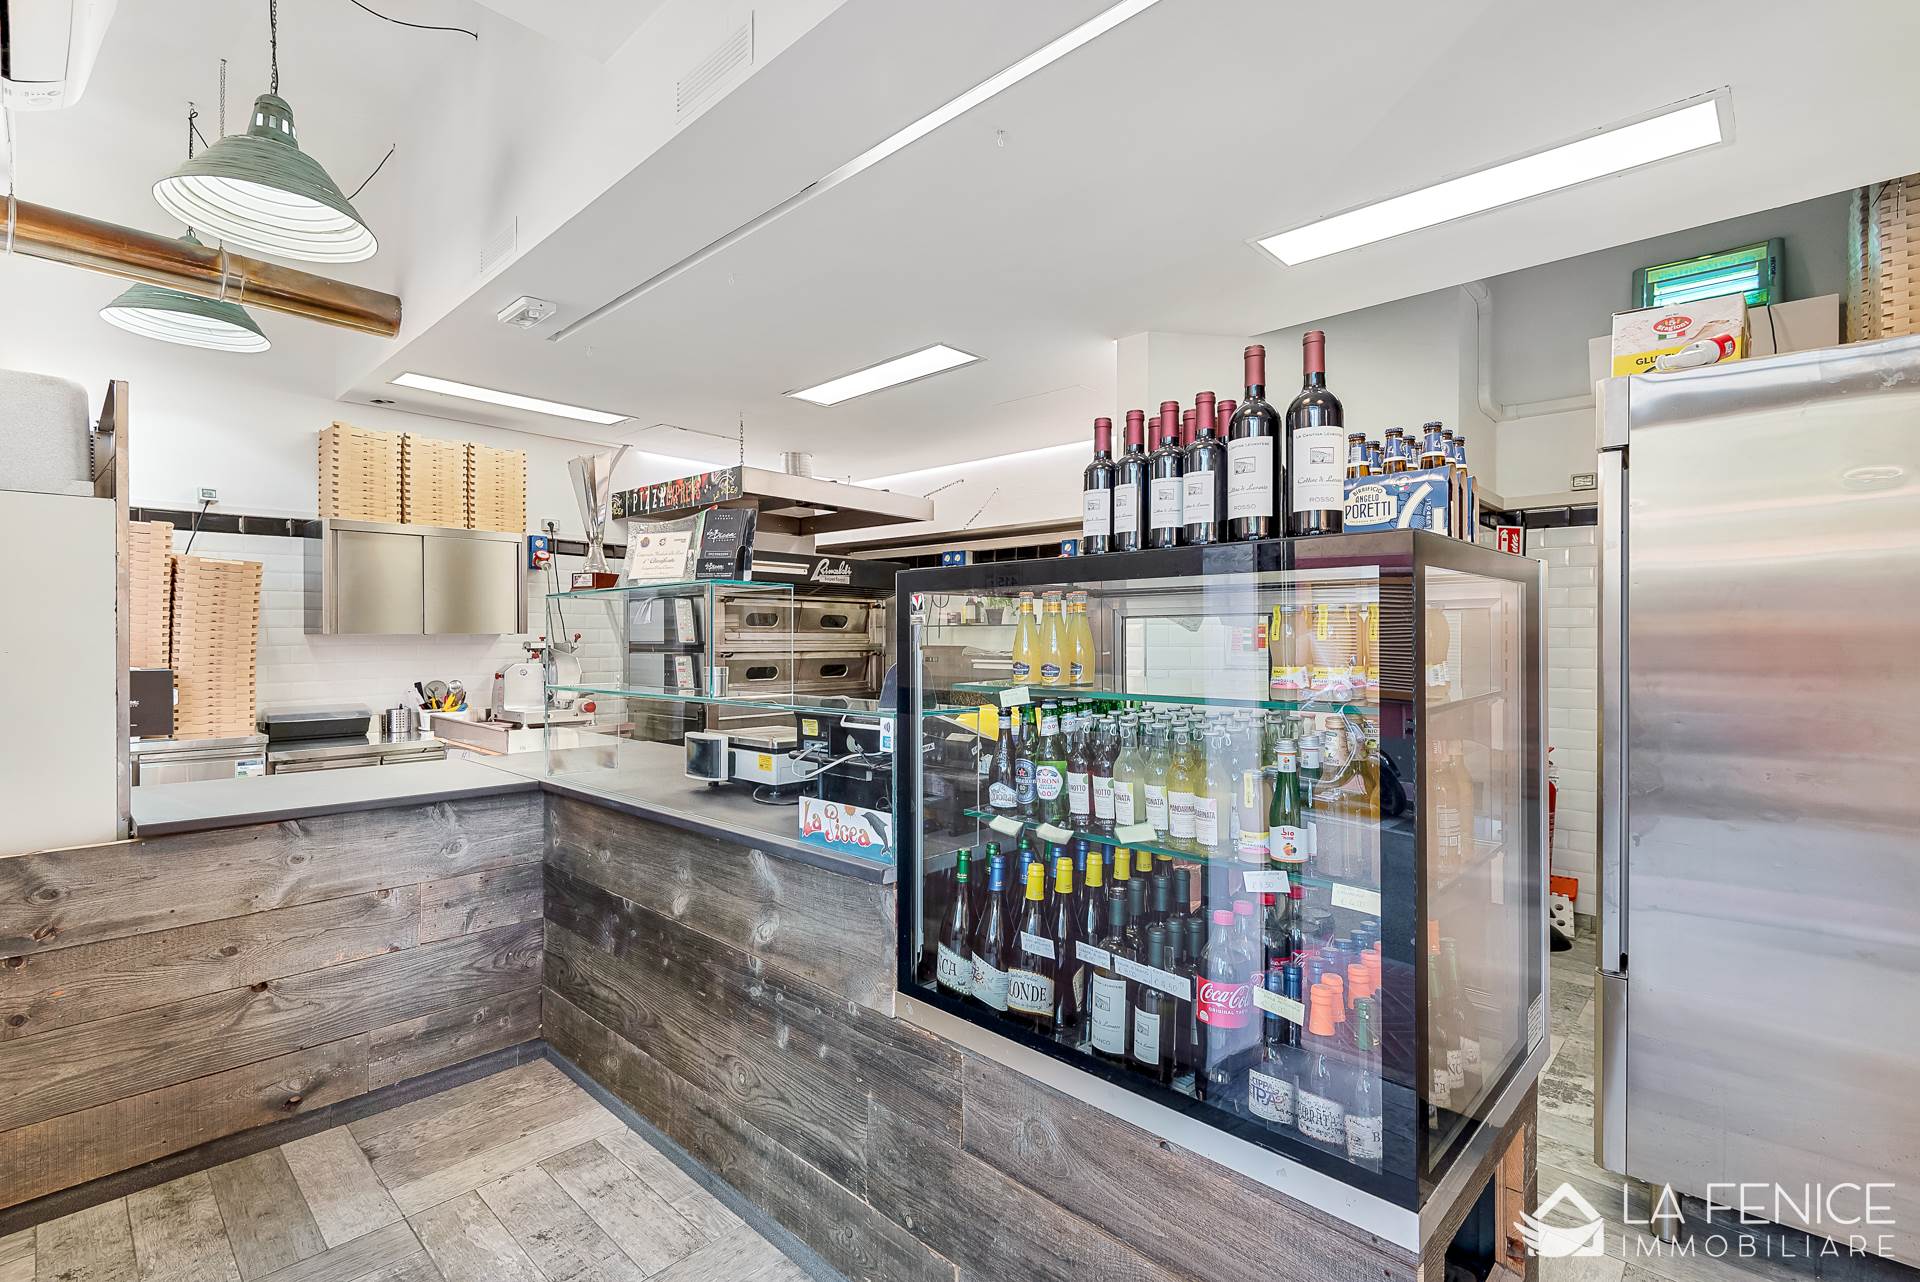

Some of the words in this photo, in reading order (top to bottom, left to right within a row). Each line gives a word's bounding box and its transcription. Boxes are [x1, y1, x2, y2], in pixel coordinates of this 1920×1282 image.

[1353, 486, 1383, 497] BIRRIFICIO
[1355, 494, 1380, 503] ANGELO
[1234, 503, 1257, 511] ROSSO
[1345, 501, 1391, 520] PORETTI
[810, 559, 852, 581] Rinaldi
[802, 800, 823, 838] La
